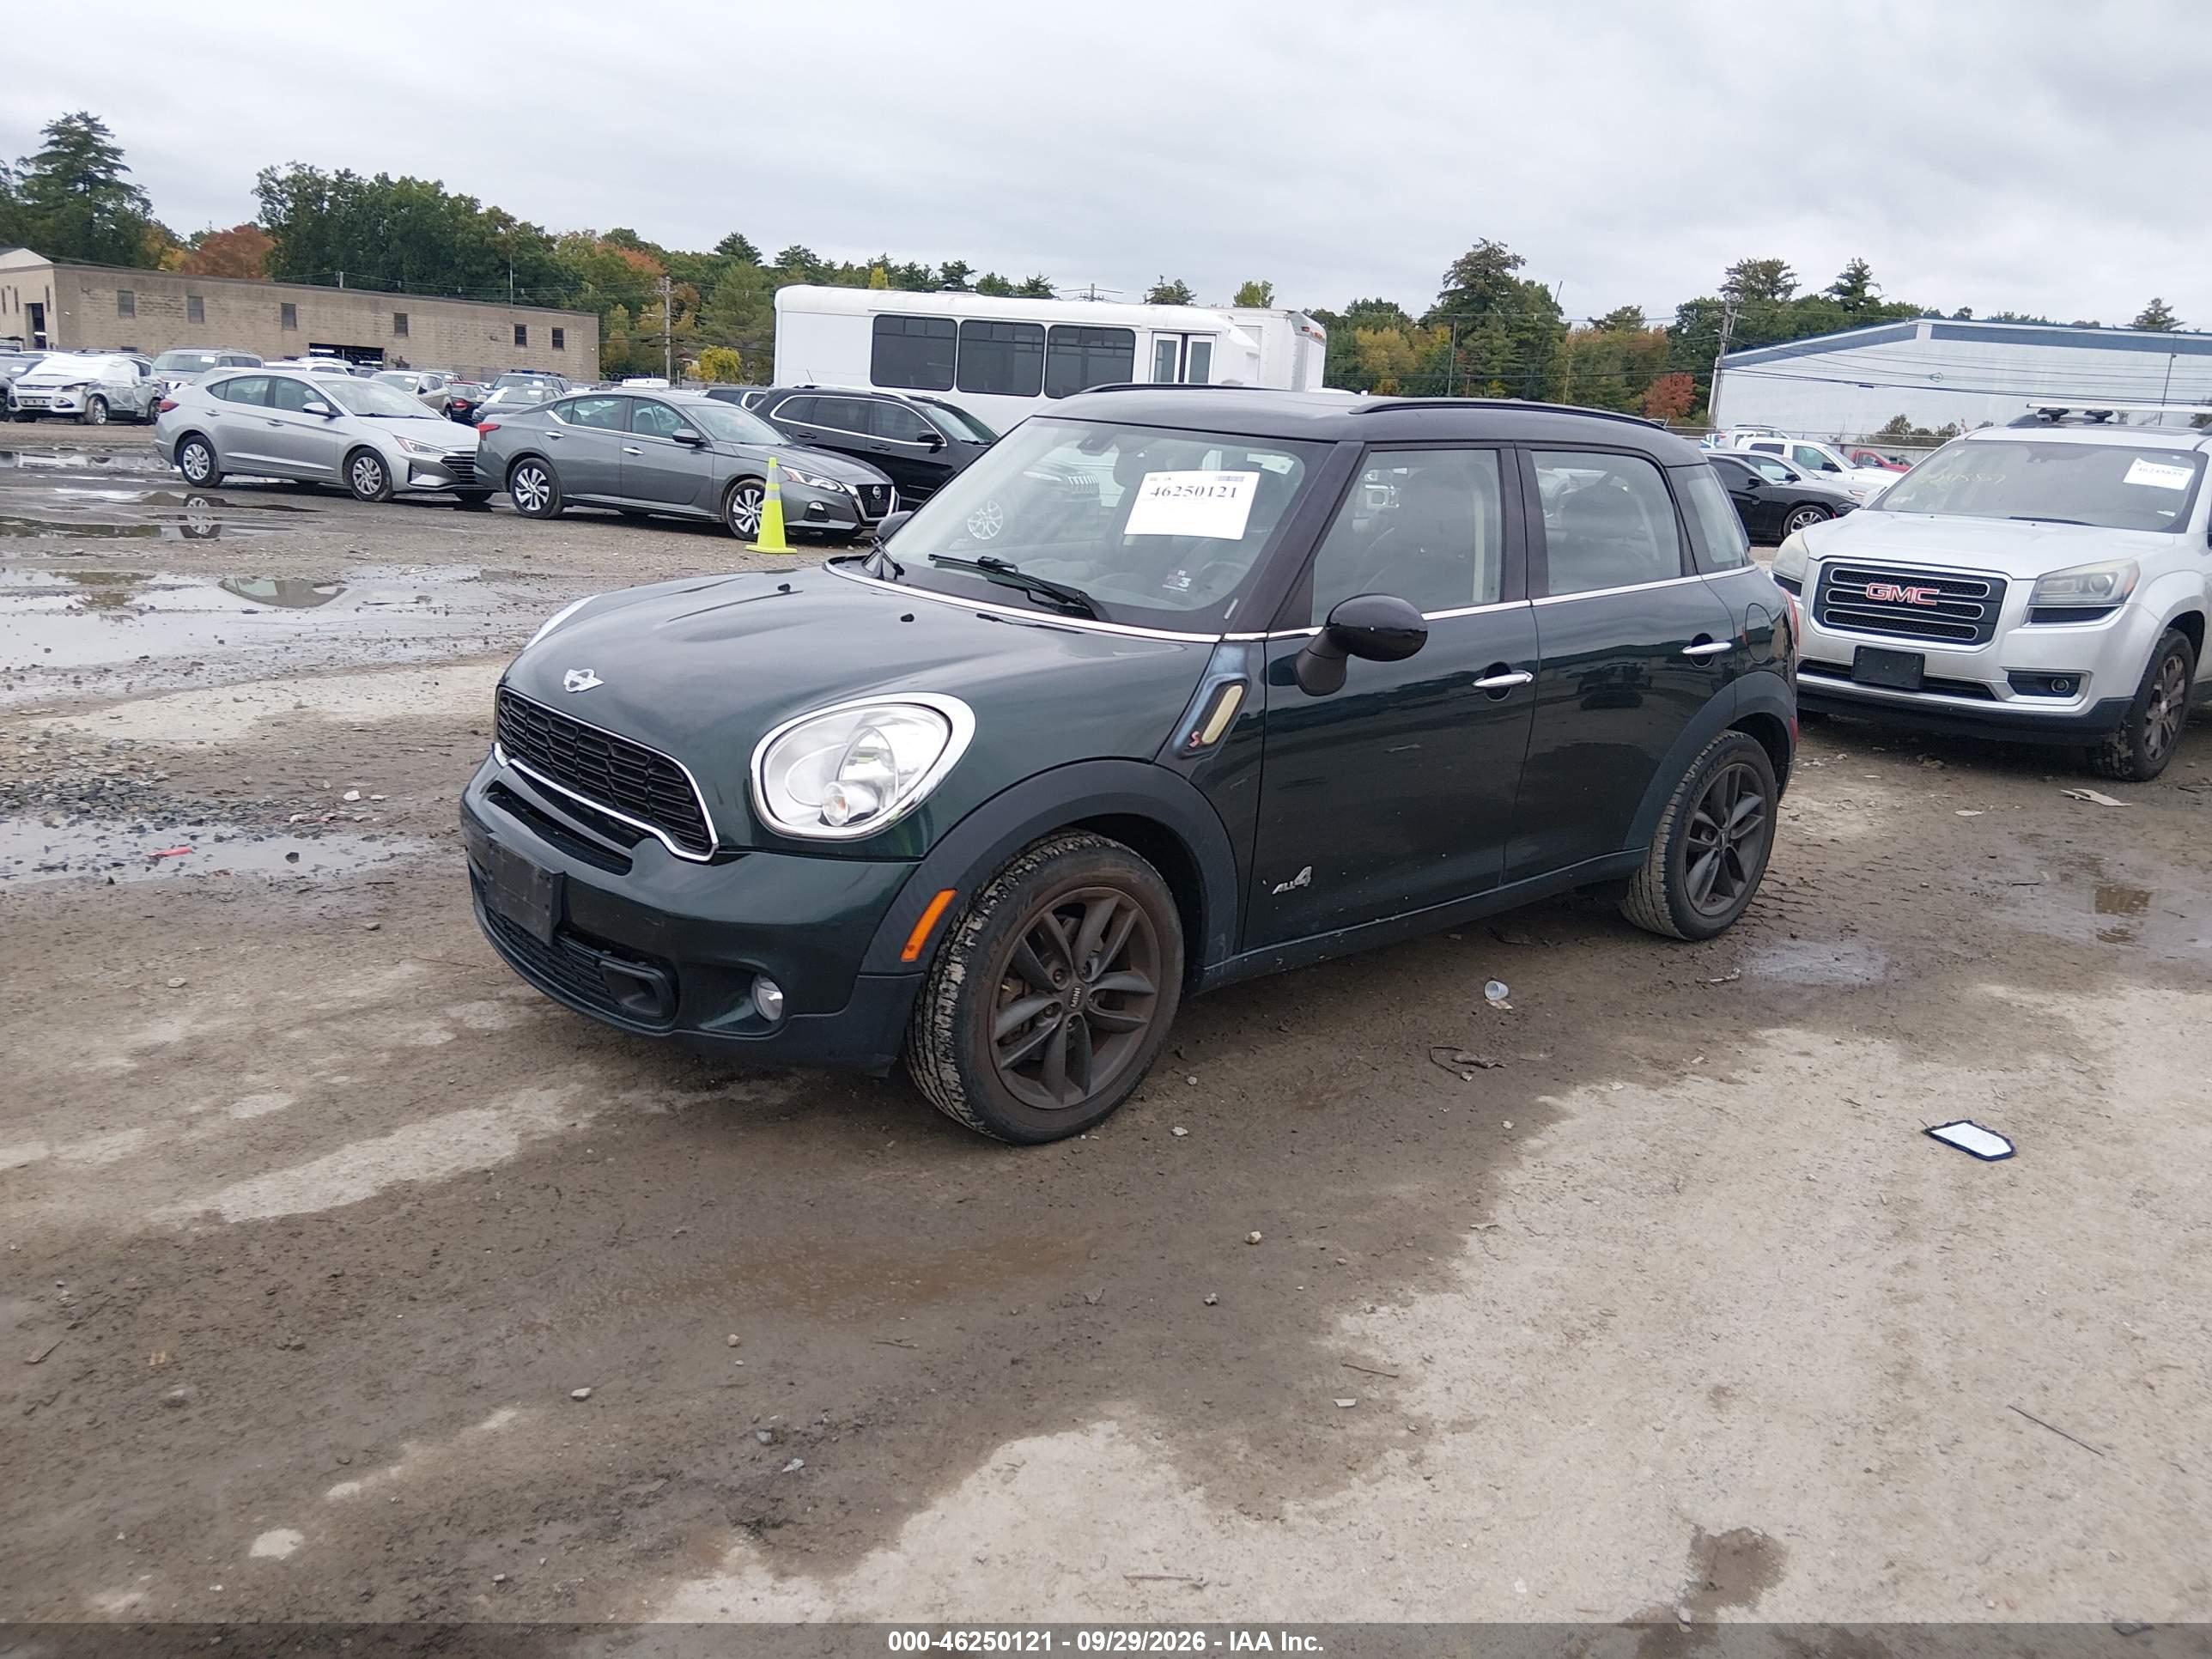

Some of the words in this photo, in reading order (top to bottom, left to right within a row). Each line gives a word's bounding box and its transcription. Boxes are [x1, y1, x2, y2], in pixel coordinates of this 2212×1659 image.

[1149, 485, 1237, 498] 46250121
[1866, 582, 1940, 605] GMC
[1069, 987, 1082, 1008] MINI
